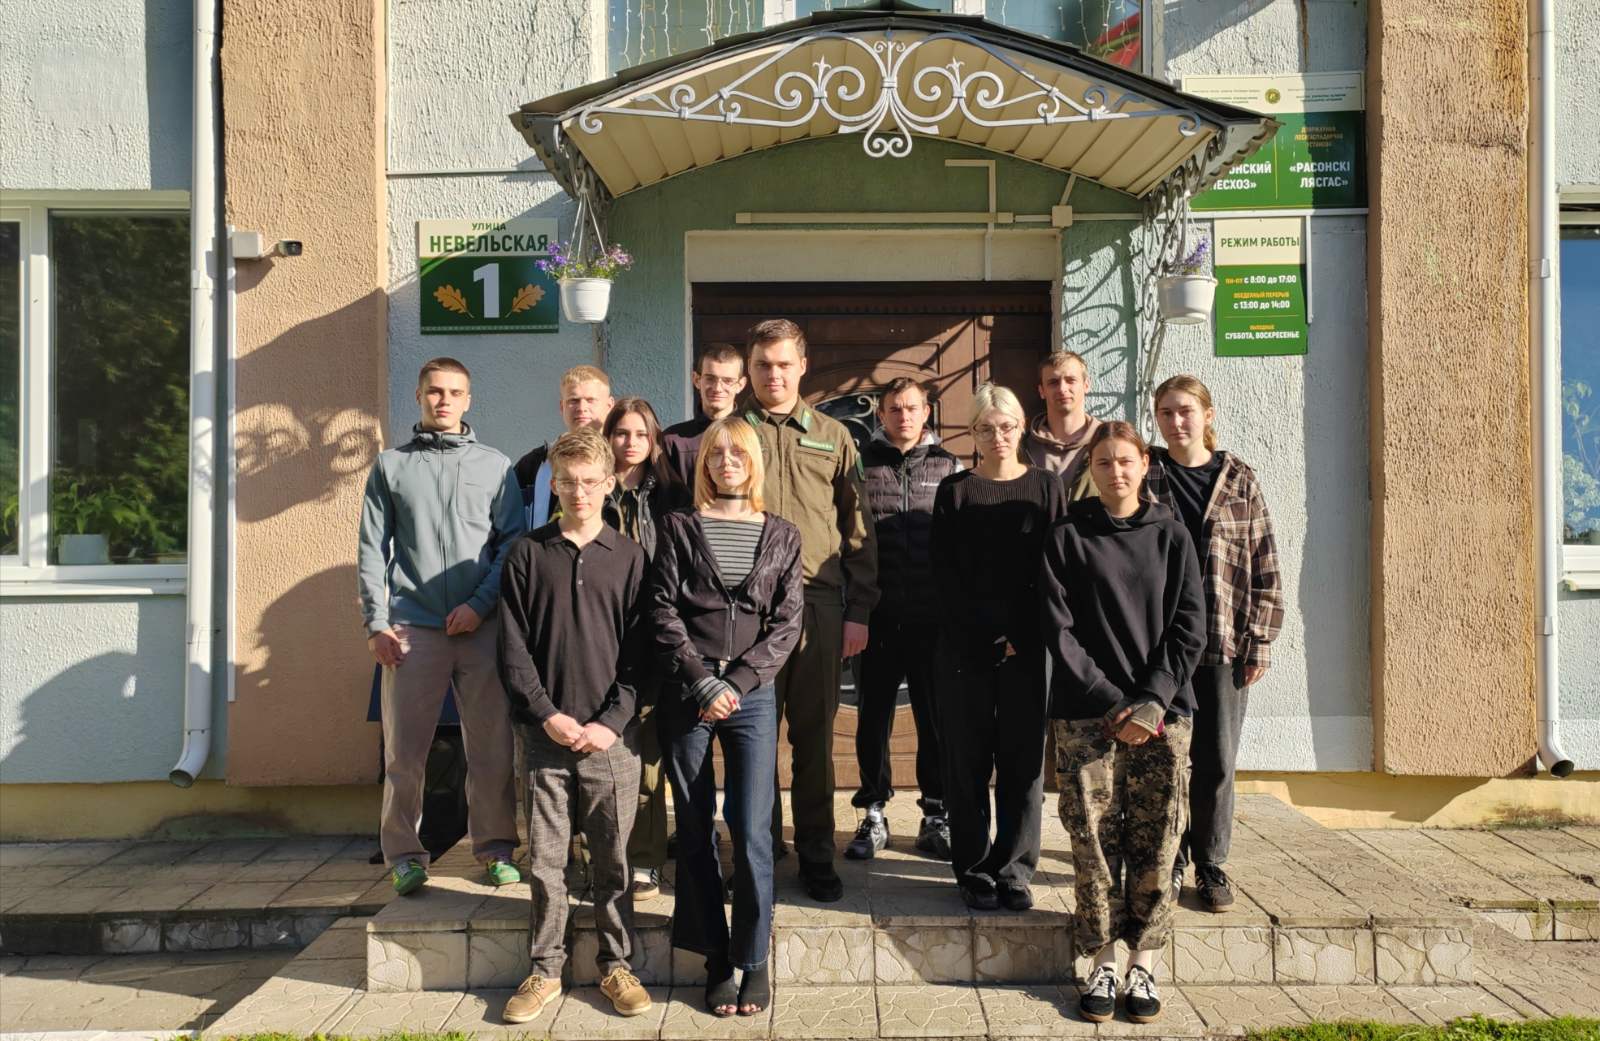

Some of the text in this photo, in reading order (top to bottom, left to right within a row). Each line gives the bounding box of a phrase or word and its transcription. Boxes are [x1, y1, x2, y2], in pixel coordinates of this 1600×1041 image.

[1299, 176, 1349, 189] ЛЯСГАС»
[472, 222, 507, 232] УЛИЦА
[430, 234, 549, 253] НЕВЕЛЬСКАЯ
[1221, 236, 1300, 248] РЕЖИМ РАБОТЫ
[1250, 275, 1266, 284] 8:00
[1267, 276, 1278, 285] до
[1278, 274, 1297, 283] 17:00
[473, 262, 500, 319] 1
[1259, 302, 1270, 310] до
[1271, 300, 1290, 309] 14:00
[1225, 331, 1300, 340] СУББОТА, ВОСКРЕСЕНЬЕ
